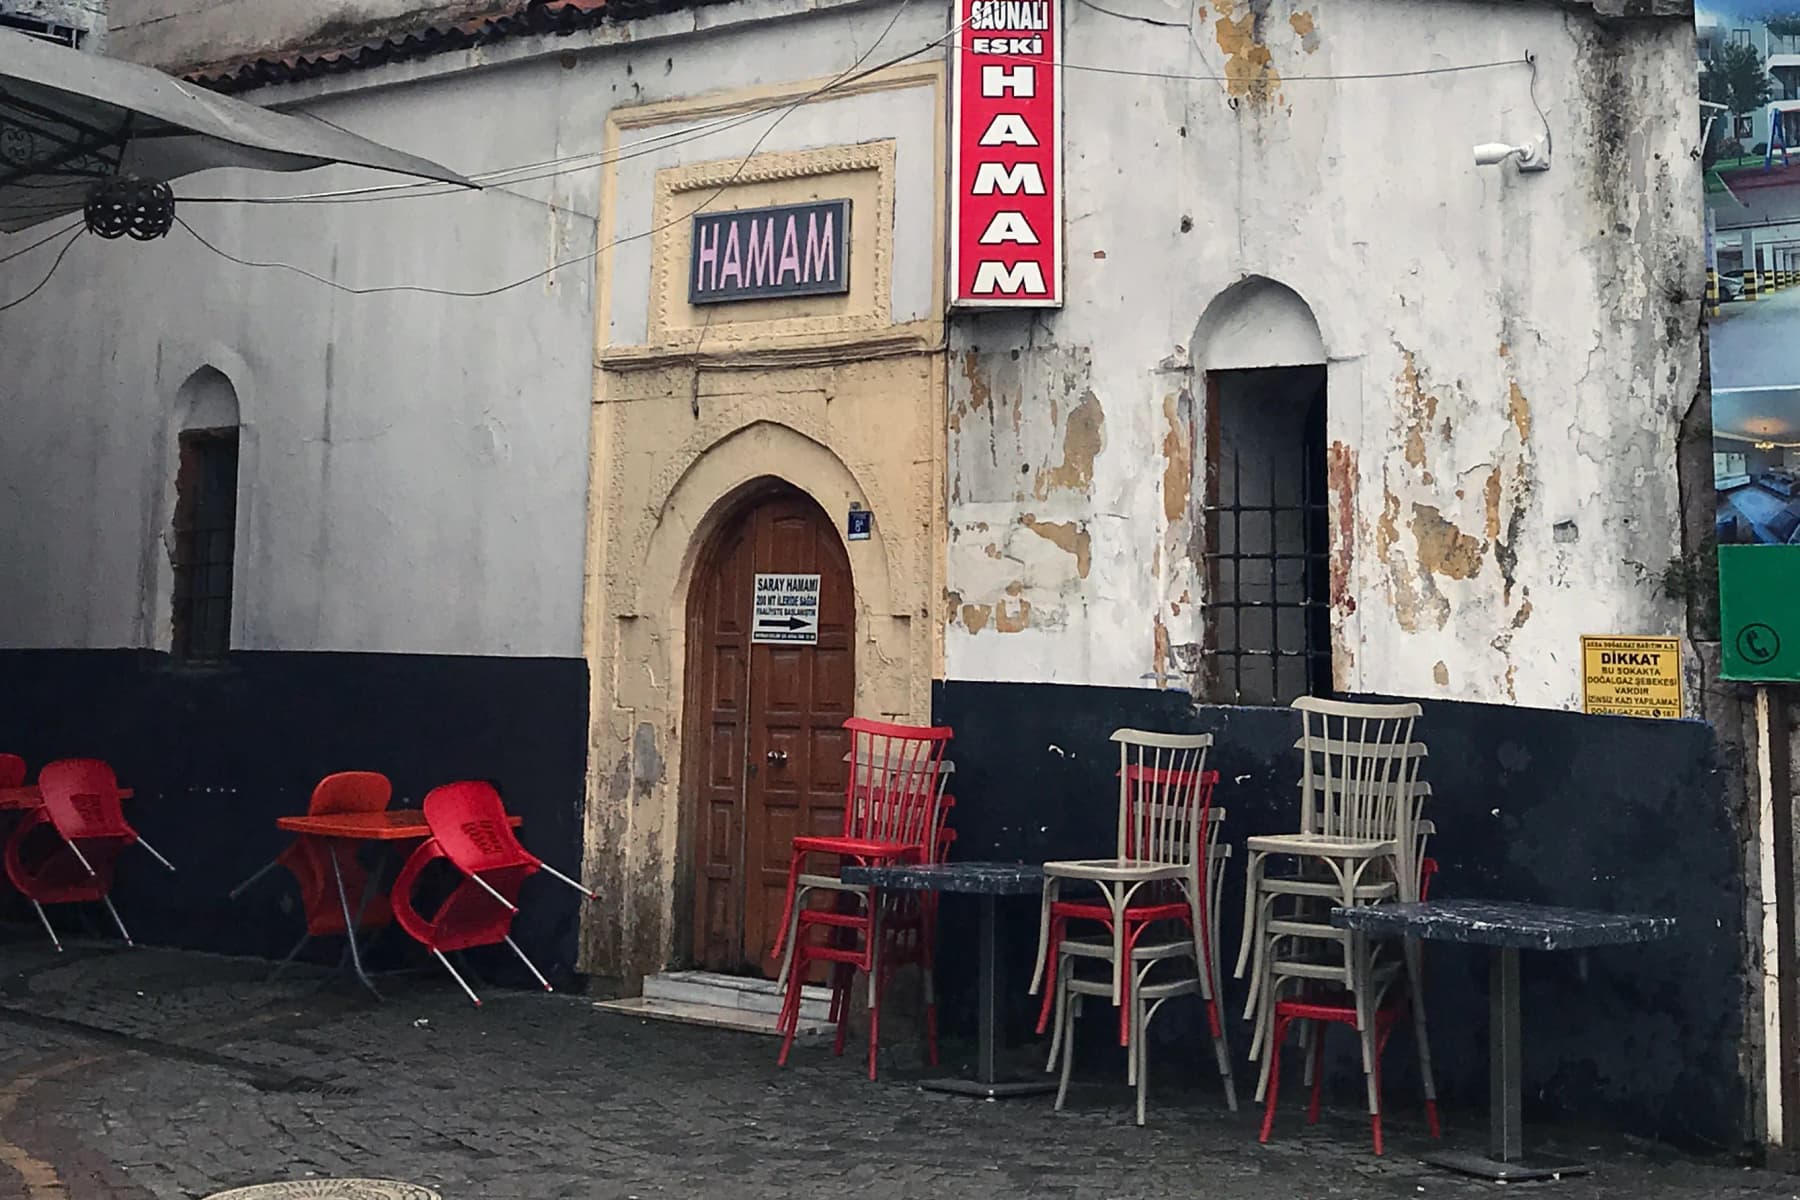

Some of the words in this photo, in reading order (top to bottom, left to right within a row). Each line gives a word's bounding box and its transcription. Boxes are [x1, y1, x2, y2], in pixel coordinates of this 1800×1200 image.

[972, 33, 1043, 55] ESKİ
[971, 65, 1047, 295] HAMAM
[698, 211, 835, 292] HAMAM
[757, 578, 784, 592] SARAY
[1601, 651, 1661, 666] DİKKAT
[1617, 667, 1661, 676] SOKAKTA
[1587, 676, 1633, 685] DOĞALGAZ
[1614, 687, 1649, 695] VARDIR
